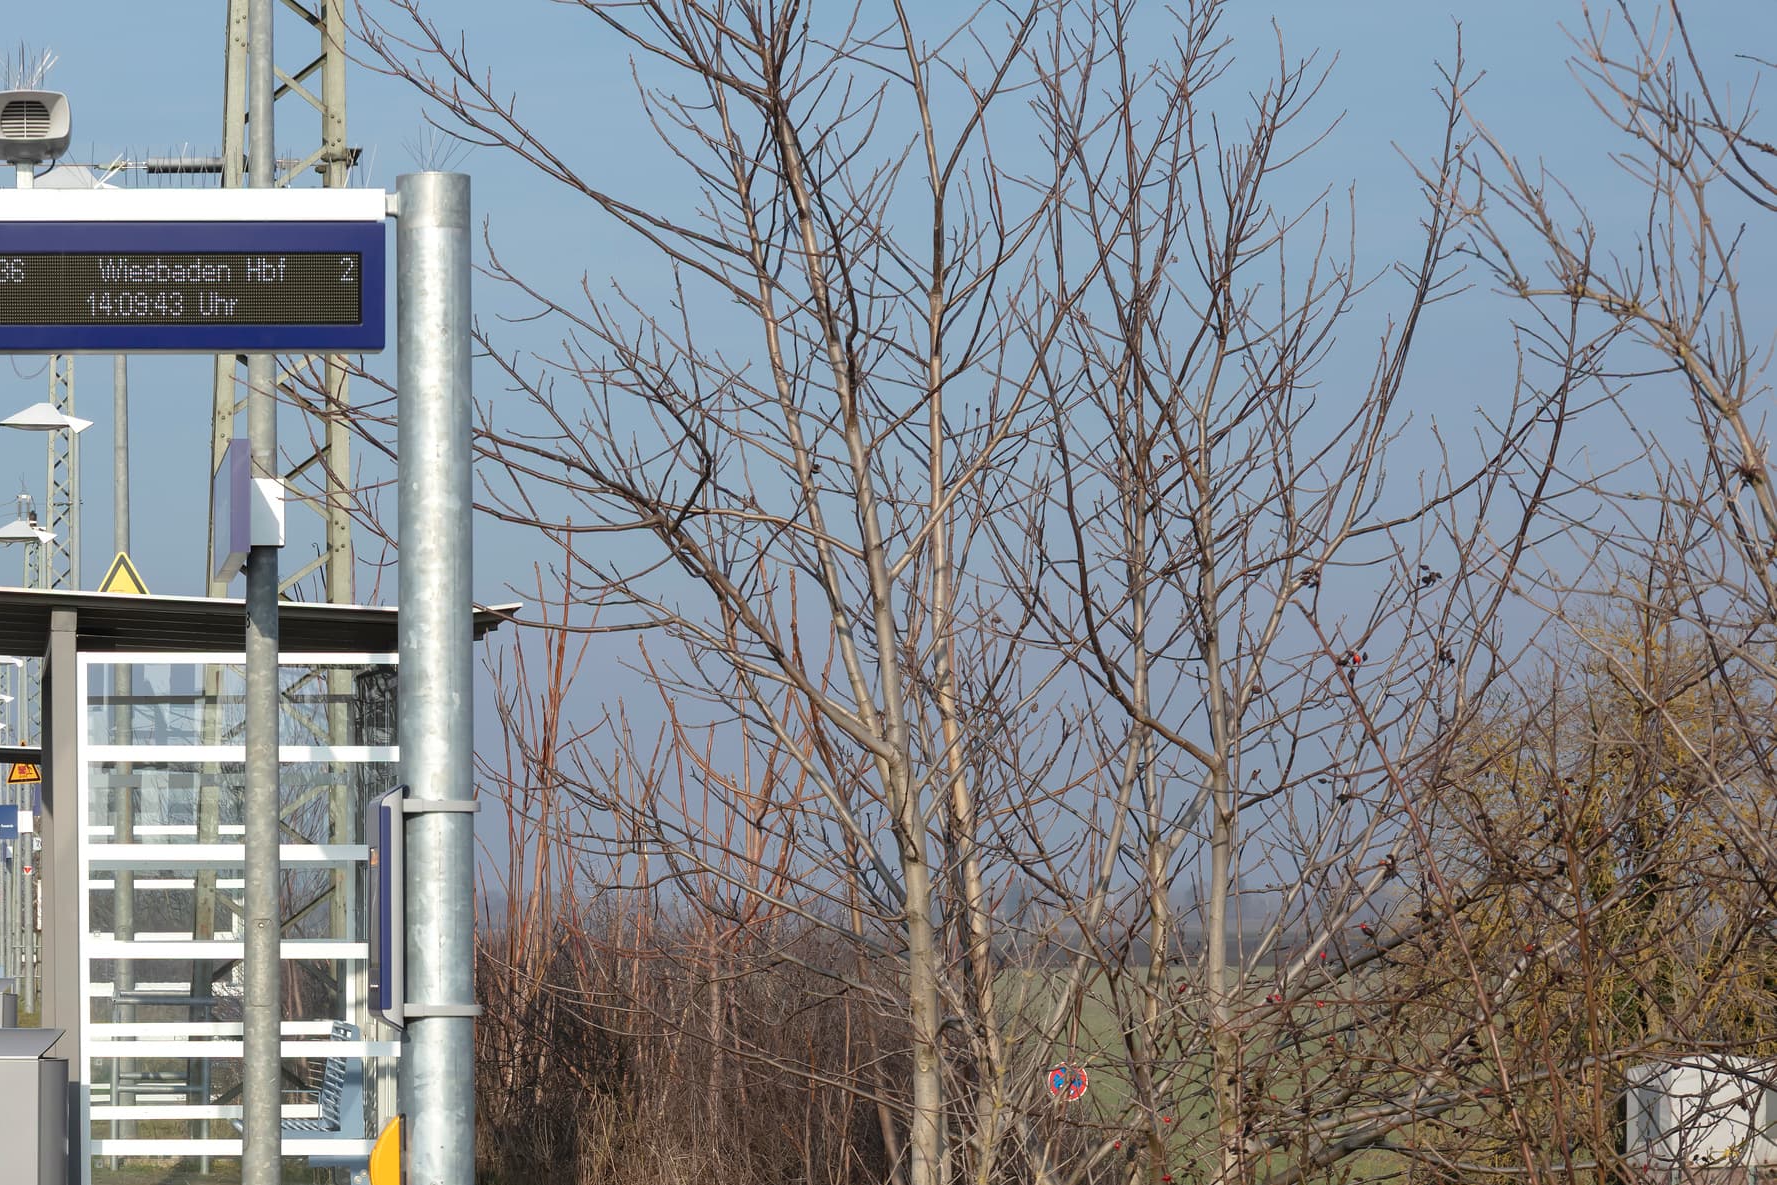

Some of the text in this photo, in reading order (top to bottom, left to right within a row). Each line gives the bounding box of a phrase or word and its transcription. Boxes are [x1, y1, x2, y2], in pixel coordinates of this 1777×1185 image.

[98, 259, 231, 282] Wiesbaden
[247, 258, 287, 282] Hbf
[340, 257, 355, 282] 2
[86, 292, 239, 316] 14:09:43 Uhr
